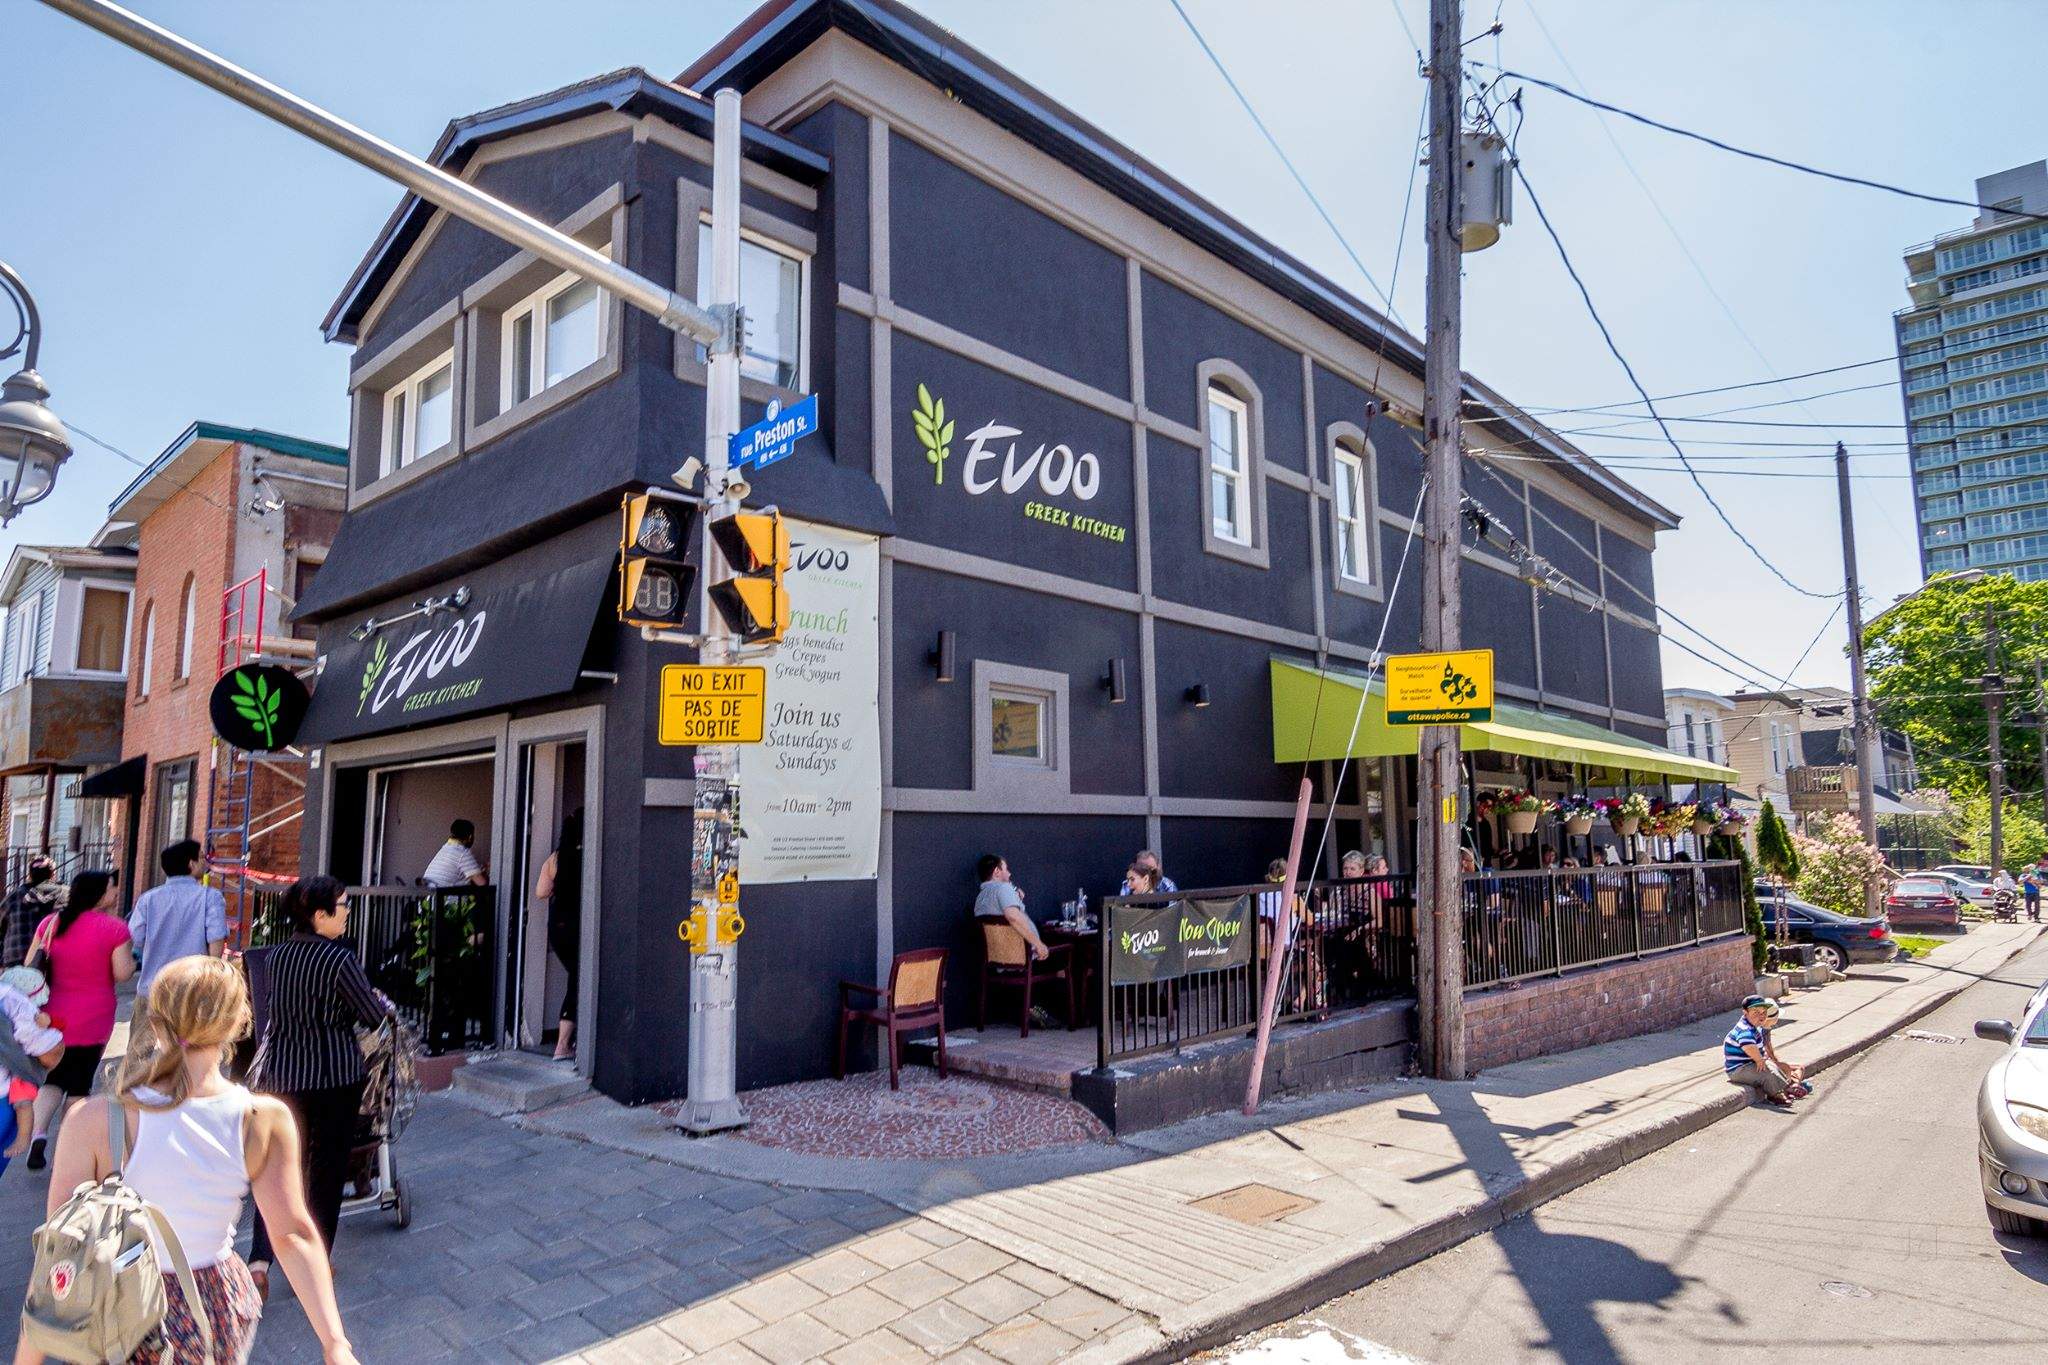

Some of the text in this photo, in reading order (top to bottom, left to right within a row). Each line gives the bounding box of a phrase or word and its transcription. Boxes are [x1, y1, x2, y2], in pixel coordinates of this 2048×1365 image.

[740, 443, 754, 459] rue
[754, 417, 795, 453] Preston
[1023, 501, 1126, 543] GREEK KITCHEN
[789, 607, 848, 634] runch
[781, 633, 844, 651] ggs benedict
[792, 650, 827, 665] Crepes
[681, 673, 746, 691] NO EXIT
[775, 662, 841, 683] Greek yogurt
[402, 678, 484, 713] GREEK KITCHEN
[684, 700, 742, 717] PAS DE
[770, 701, 841, 728] Join us
[1407, 711, 1471, 721] ottawapolice.ca
[684, 720, 741, 738] SORTIE
[765, 729, 838, 755] Saturdays
[775, 751, 837, 776] Sundays
[825, 796, 852, 817] 2pm
[1179, 916, 1241, 946] Now Open
